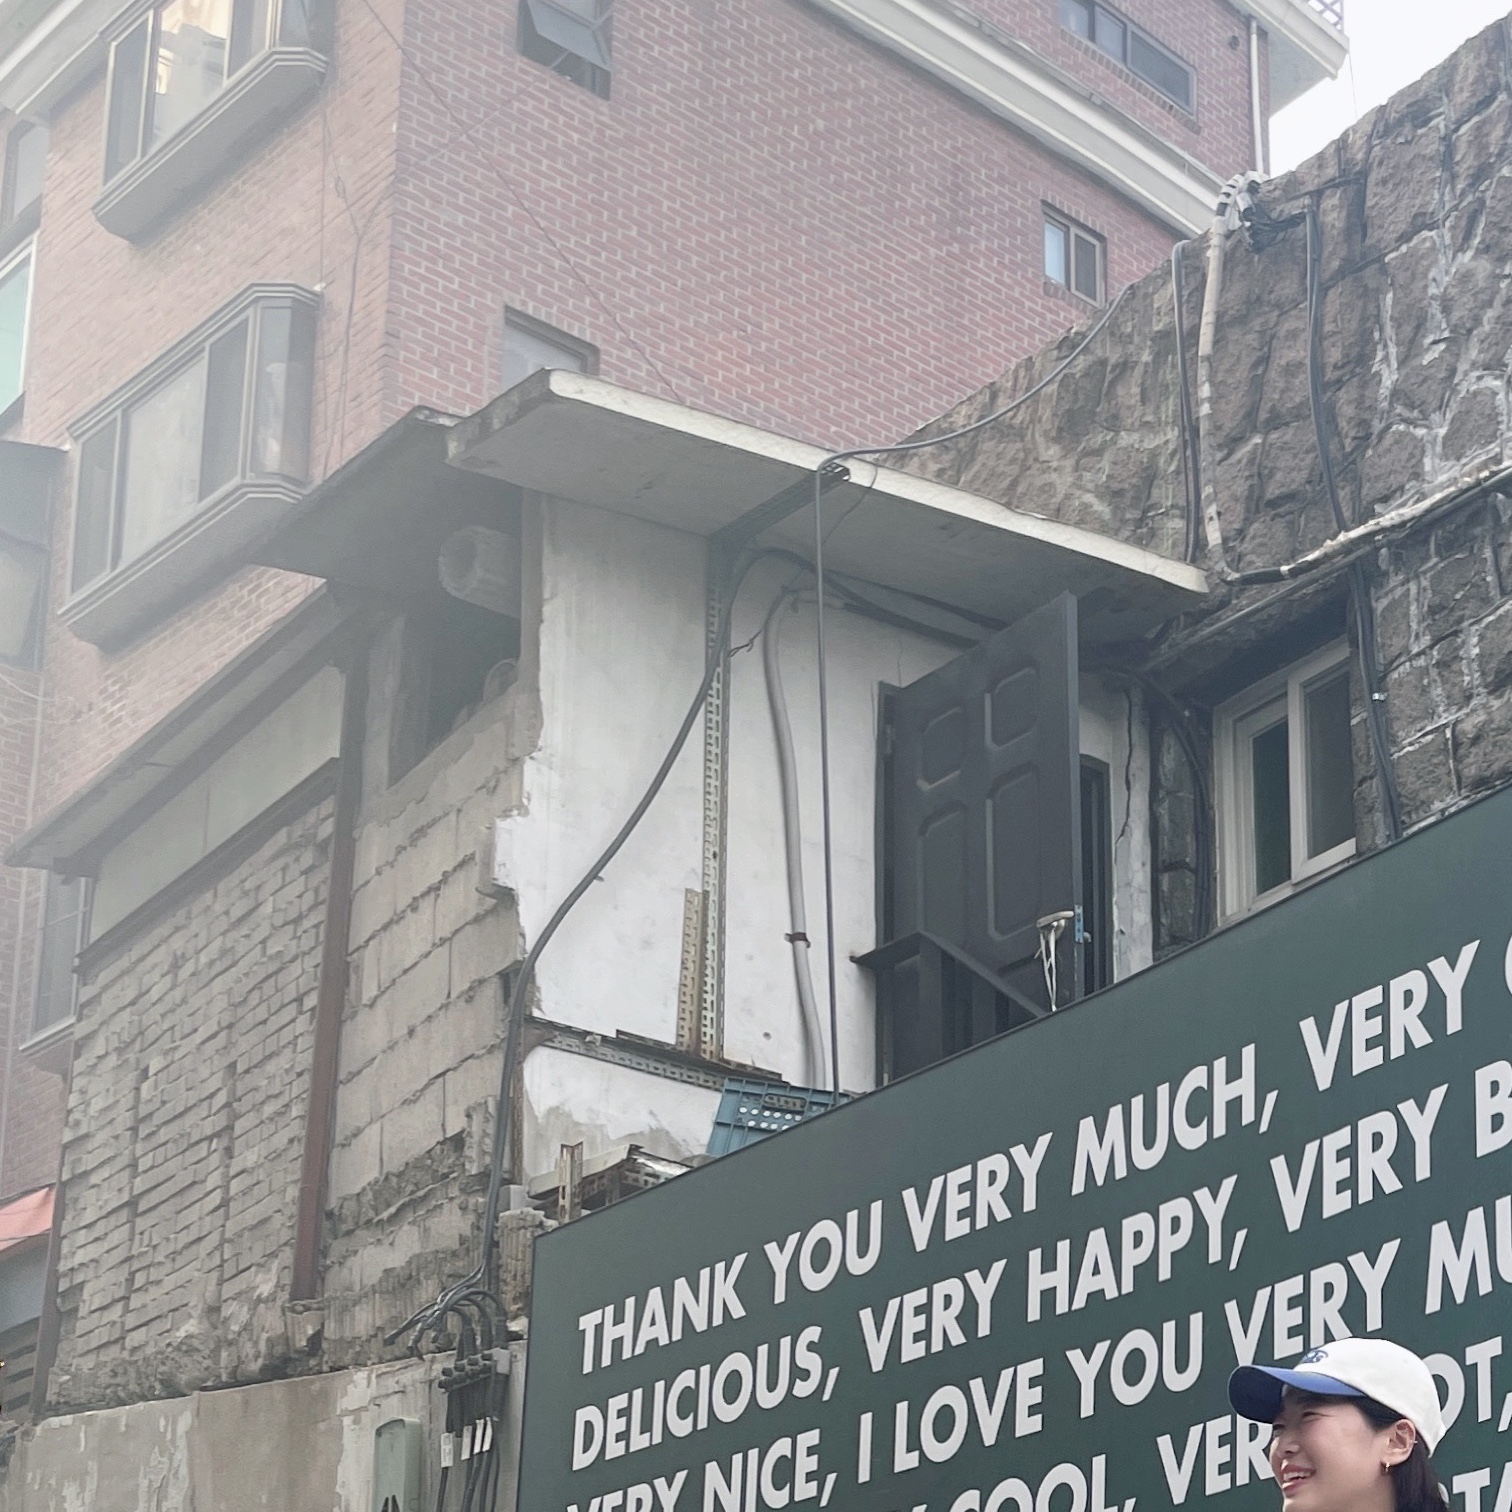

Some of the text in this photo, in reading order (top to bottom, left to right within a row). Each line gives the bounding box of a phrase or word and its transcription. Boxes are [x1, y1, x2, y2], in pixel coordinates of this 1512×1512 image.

[571, 1326, 840, 1472] DELICIOUS,
[858, 1259, 1006, 1374] VERY
[1026, 1175, 1247, 1323] HAPPY,
[1269, 1084, 1449, 1232] VERY
[578, 1253, 749, 1375] THANK
[763, 1200, 884, 1304] YOU
[902, 1133, 1053, 1253] VERY
[1070, 1043, 1281, 1196] MUCH,
[1299, 940, 1480, 1092] VERY
[857, 1412, 872, 1485] I
[892, 1357, 1045, 1474] LOVE
[1065, 1313, 1203, 1419] YOU
[1223, 1239, 1401, 1366] VERY
[1156, 1410, 1275, 1507] VER
